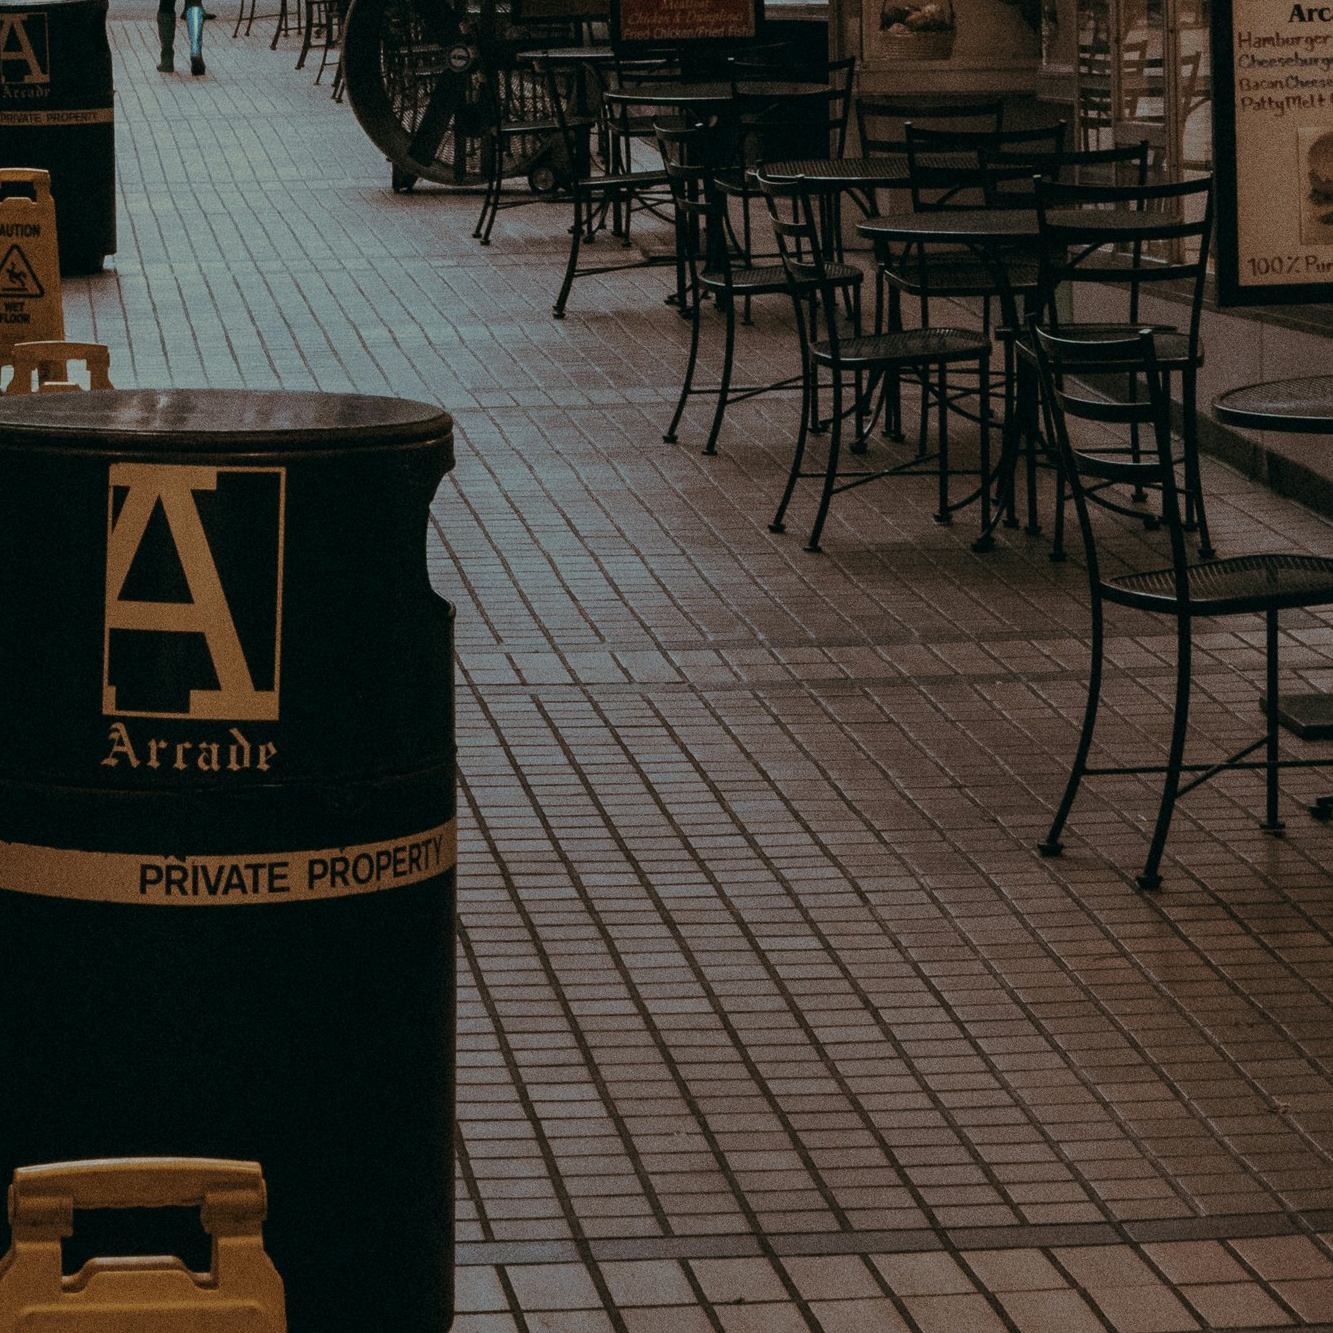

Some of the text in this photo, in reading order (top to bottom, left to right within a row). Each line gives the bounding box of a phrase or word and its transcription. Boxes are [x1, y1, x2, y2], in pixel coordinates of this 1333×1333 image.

[0, 12, 50, 84] A
[1237, 31, 1332, 51] Hamburger
[3, 84, 51, 98] Arcade
[0, 111, 98, 123] PRIVATE PROPERTY
[1247, 255, 1301, 277] 100%
[3, 302, 25, 312] WET
[0, 313, 31, 324] FLOOR
[102, 463, 286, 722] A
[99, 721, 280, 771] Arcade
[138, 832, 445, 898] PRIVATE PROPERTY
